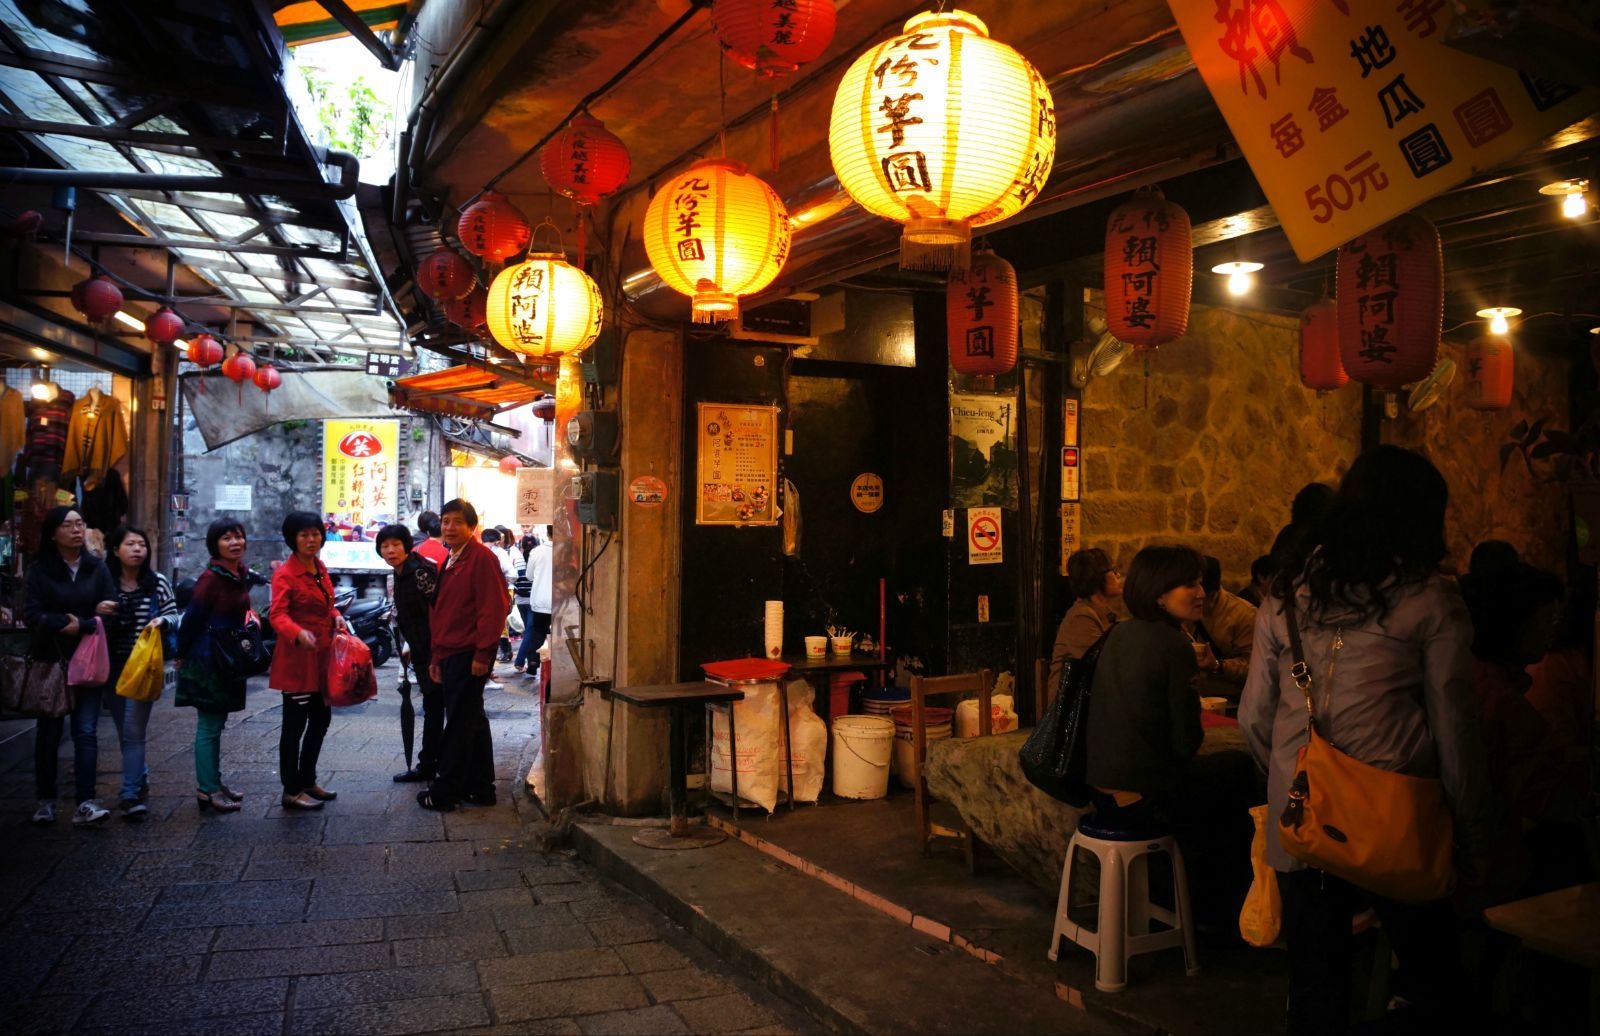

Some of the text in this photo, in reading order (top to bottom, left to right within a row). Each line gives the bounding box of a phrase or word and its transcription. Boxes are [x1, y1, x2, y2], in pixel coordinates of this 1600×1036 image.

[1269, 86, 1350, 159] 每盒
[1350, 24, 1453, 178] 地瓜圓
[674, 176, 711, 262] 九份芋圓
[1304, 150, 1390, 224] 50元
[511, 266, 544, 346] 賴阿婆
[964, 286, 995, 359] 芋圓
[1120, 234, 1161, 330] 賴阿婆
[1355, 252, 1399, 364] 賴阿婆
